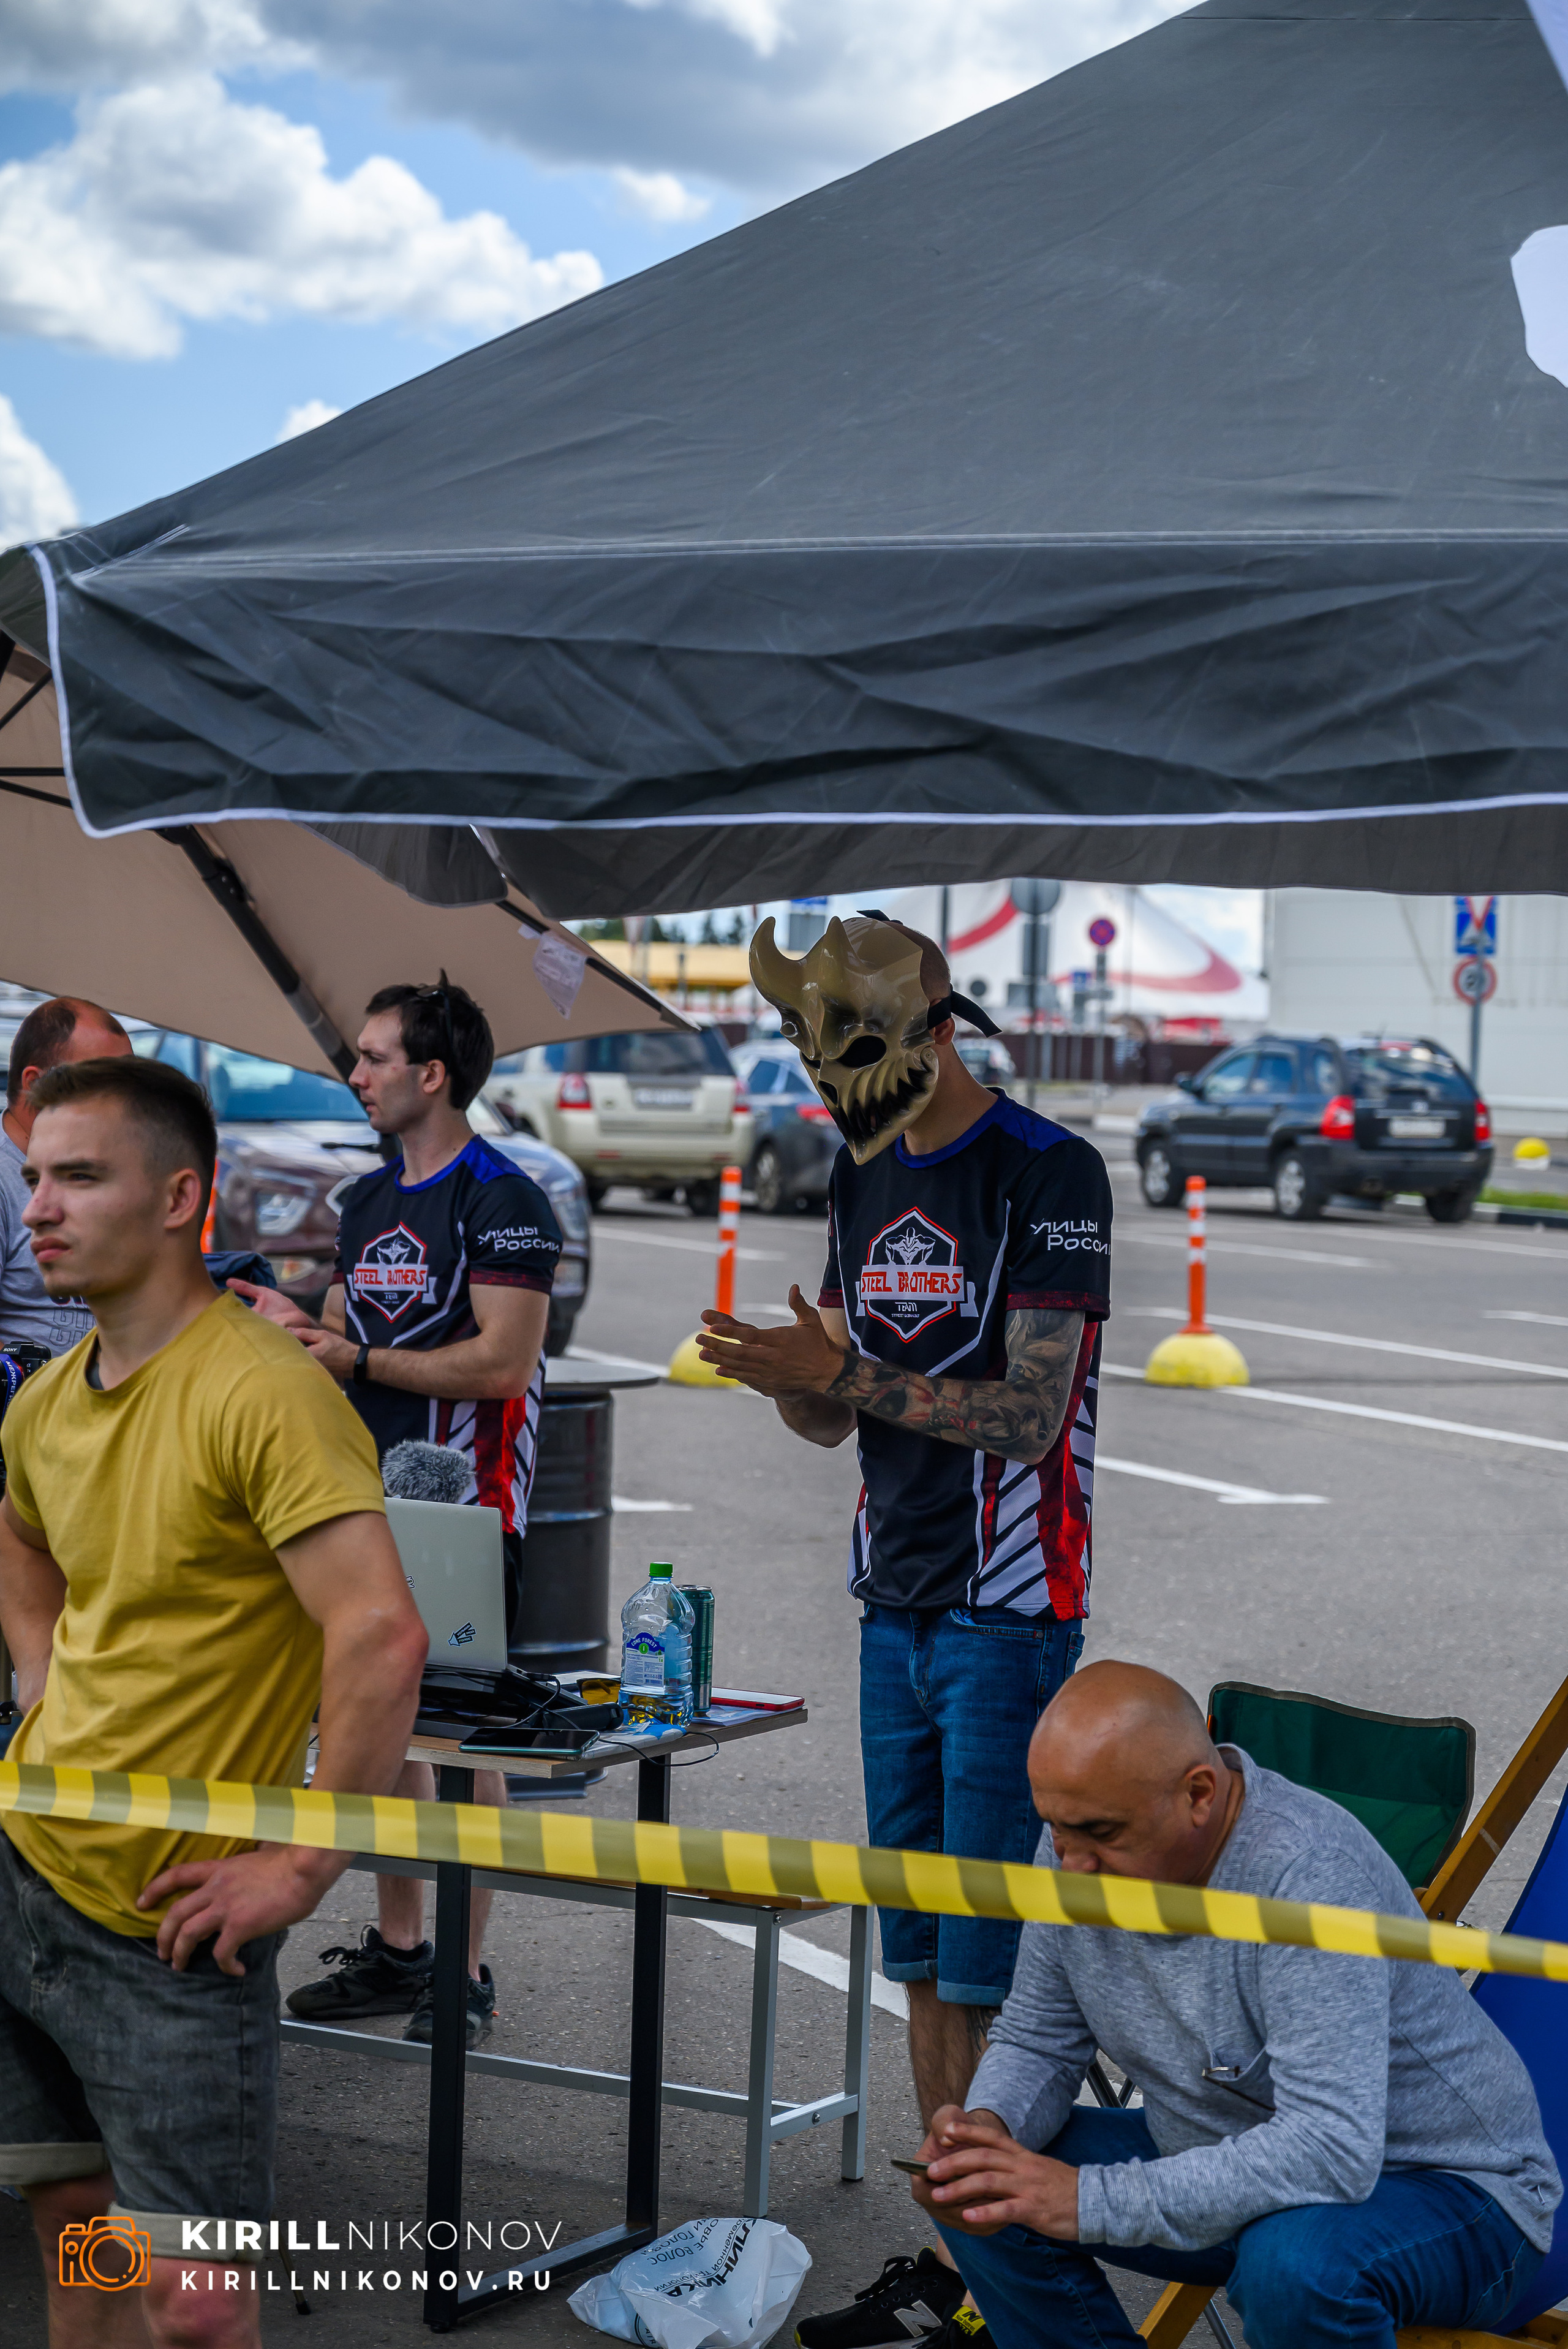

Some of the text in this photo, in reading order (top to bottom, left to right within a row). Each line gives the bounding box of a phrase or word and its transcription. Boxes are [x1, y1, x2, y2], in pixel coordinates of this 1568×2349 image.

[477, 1226, 538, 1245] Улицы
[1030, 1219, 1098, 1235] Улицы
[355, 1269, 383, 1285] STEEL
[861, 1271, 963, 1294] STEEL BROTHERS
[895, 1302, 918, 1312] TEAM
[642, 1637, 657, 1648] FOREST
[711, 2218, 745, 2272] ременной
[650, 2247, 695, 2266] ВОЛОС
